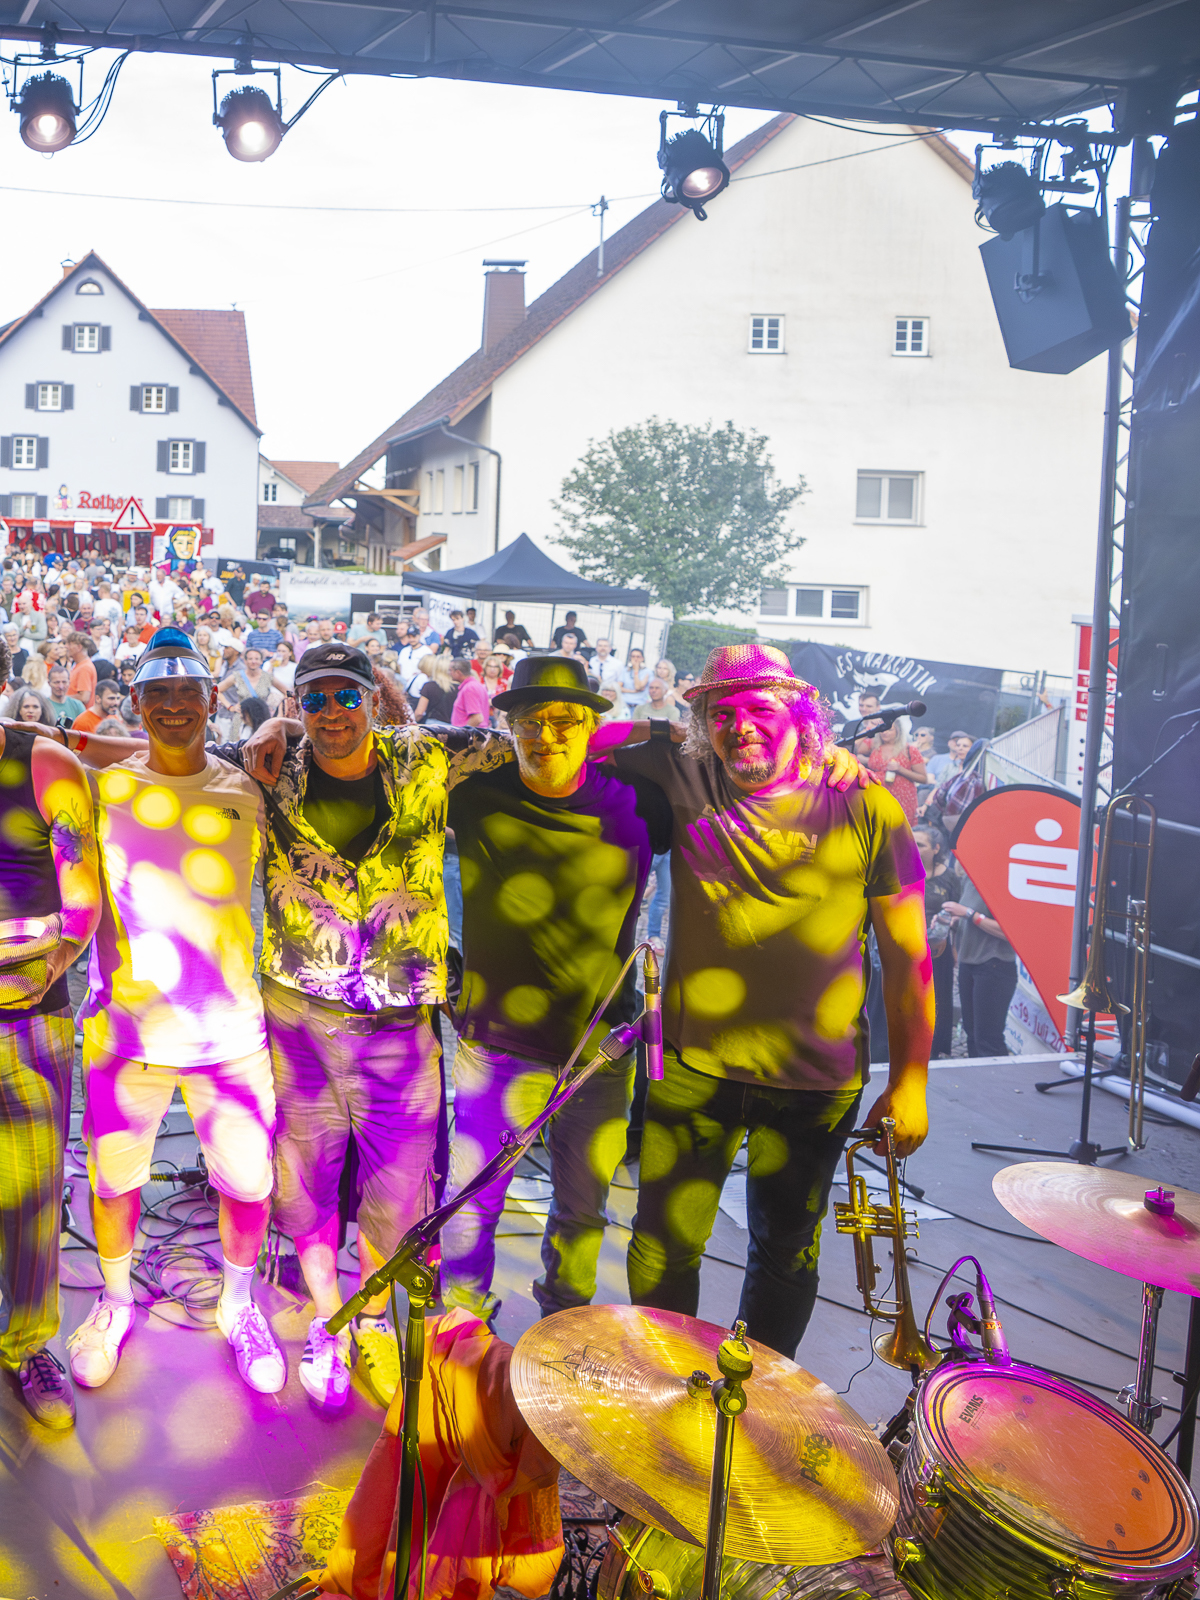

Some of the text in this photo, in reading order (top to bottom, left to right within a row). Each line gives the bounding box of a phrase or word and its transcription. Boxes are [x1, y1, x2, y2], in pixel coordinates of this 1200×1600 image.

[77, 491, 143, 512] Rotha
[836, 652, 853, 679] LES
[959, 1394, 984, 1424] EVANS
